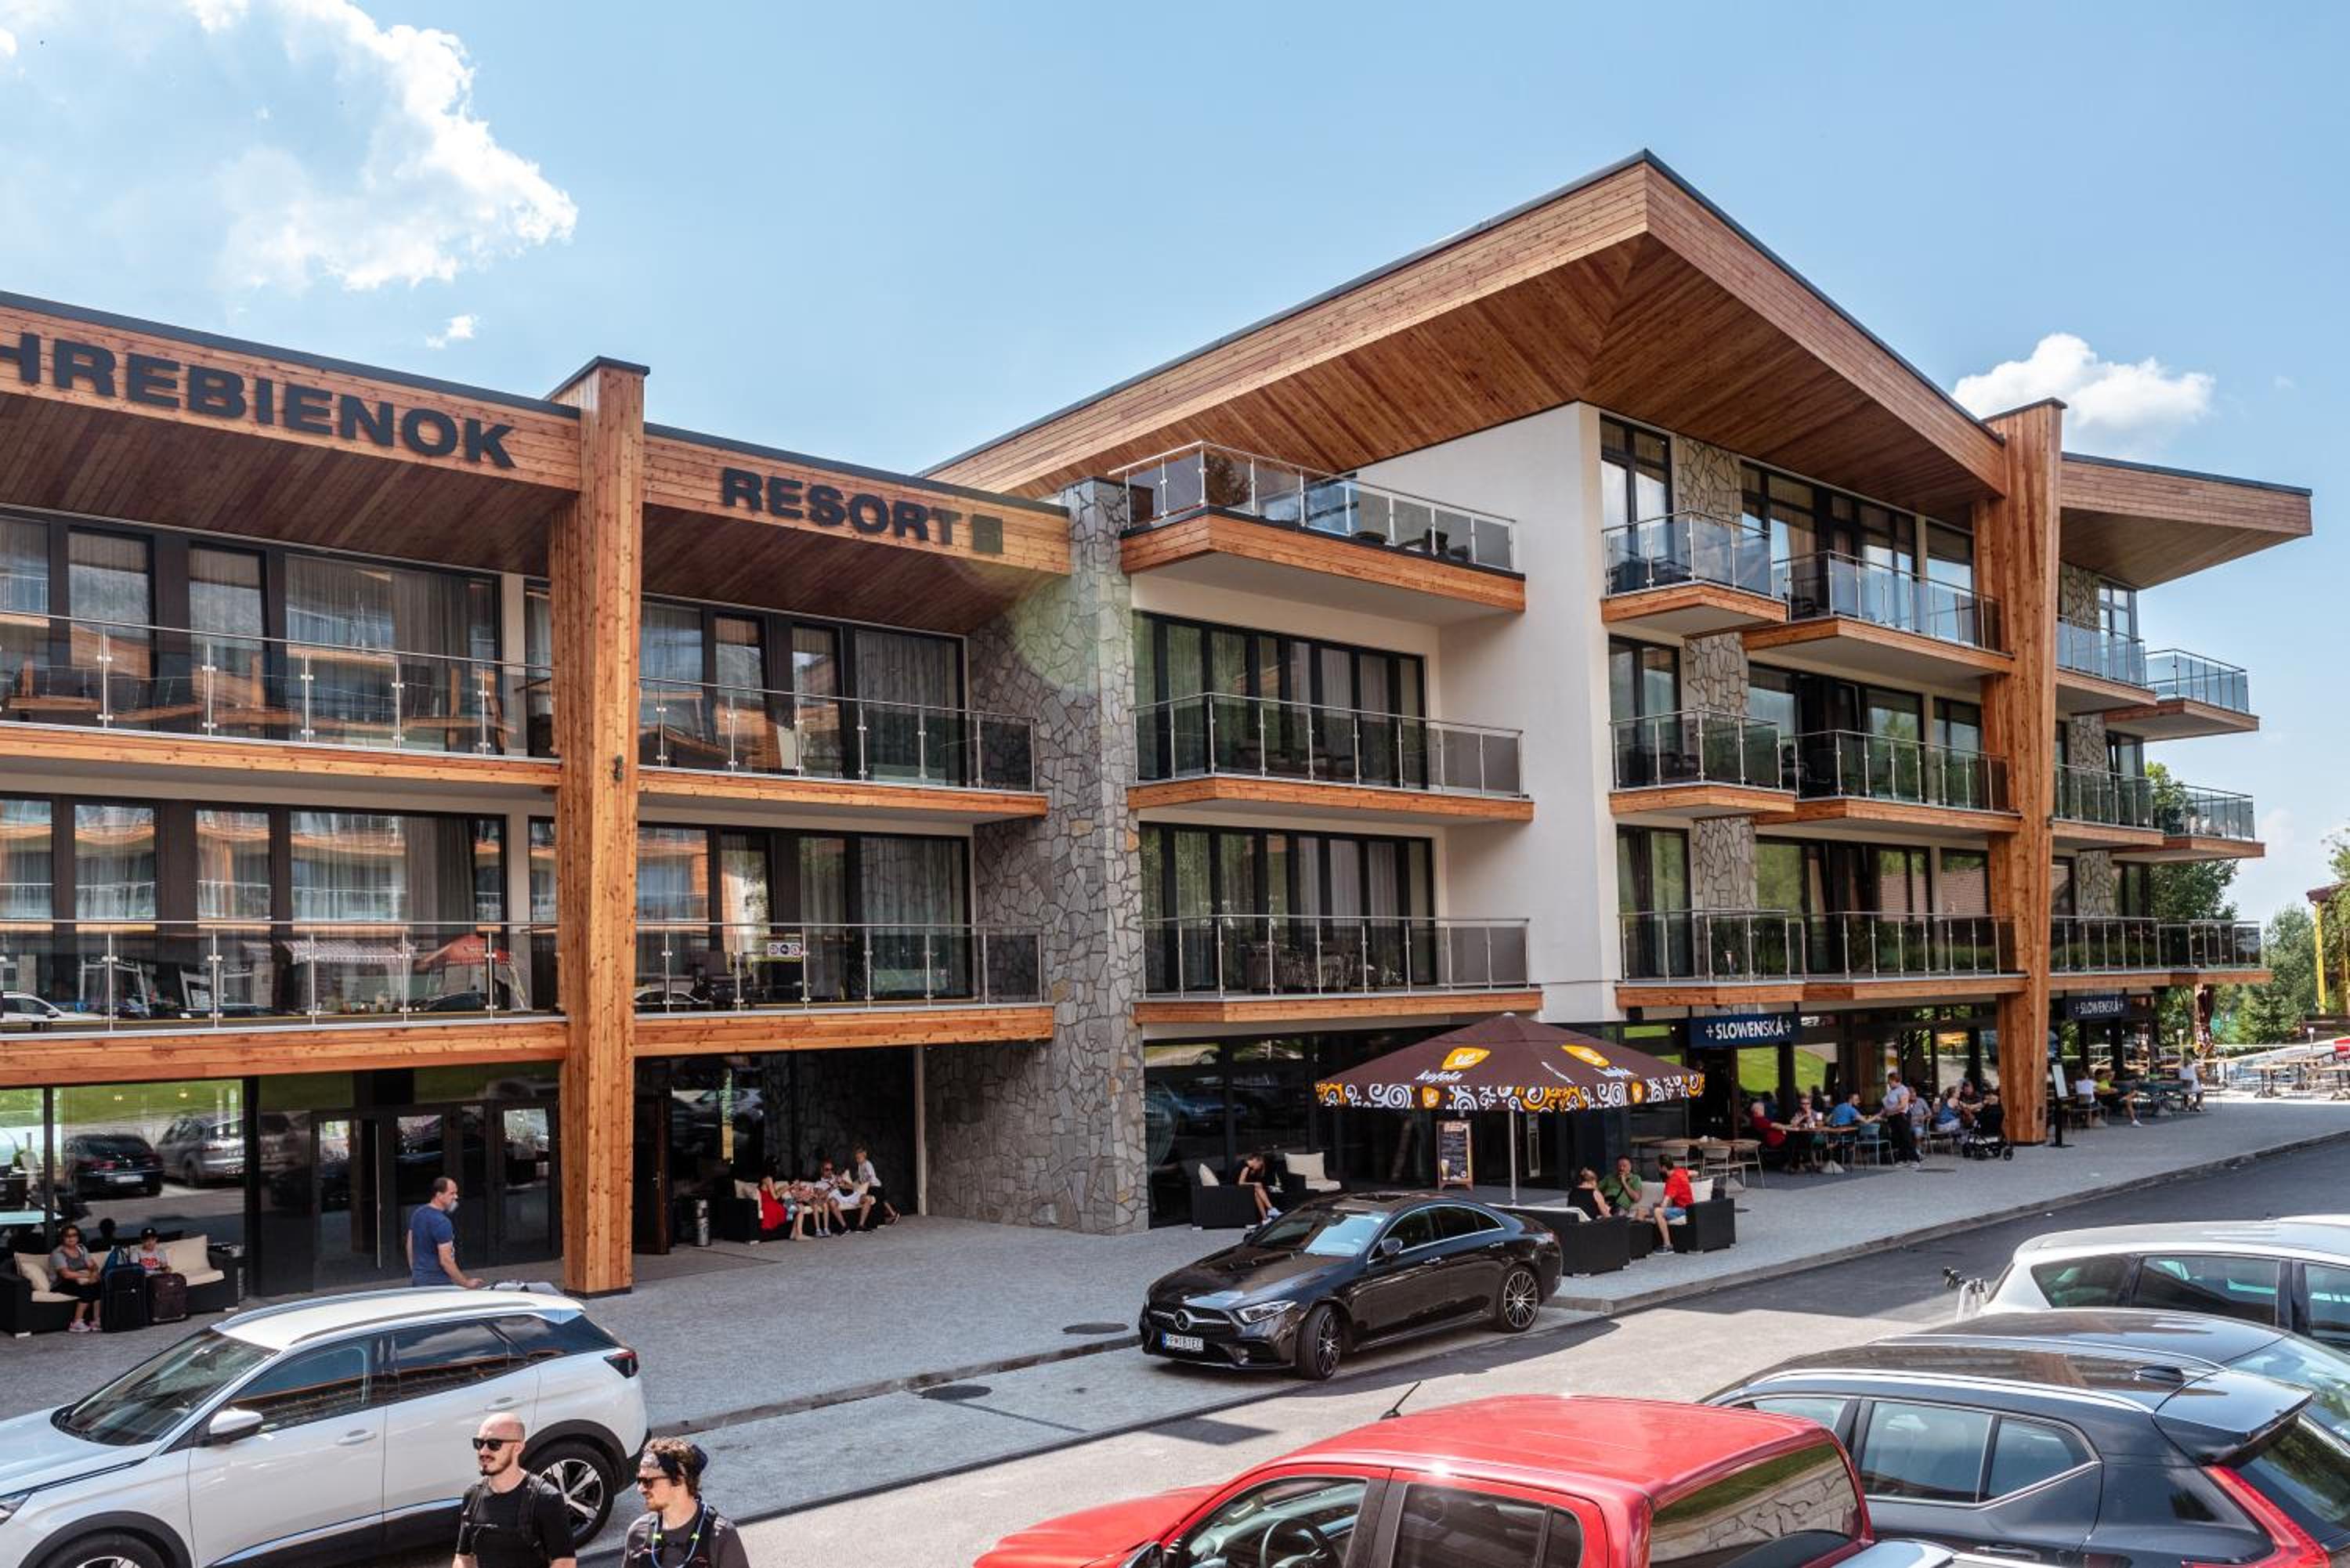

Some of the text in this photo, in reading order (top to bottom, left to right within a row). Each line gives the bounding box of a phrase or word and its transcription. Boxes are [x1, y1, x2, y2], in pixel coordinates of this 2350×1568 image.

[0, 332, 517, 468] HREBIENOK
[721, 467, 962, 546] RESORT
[1715, 1017, 1784, 1040] SLOWENSKÁ
